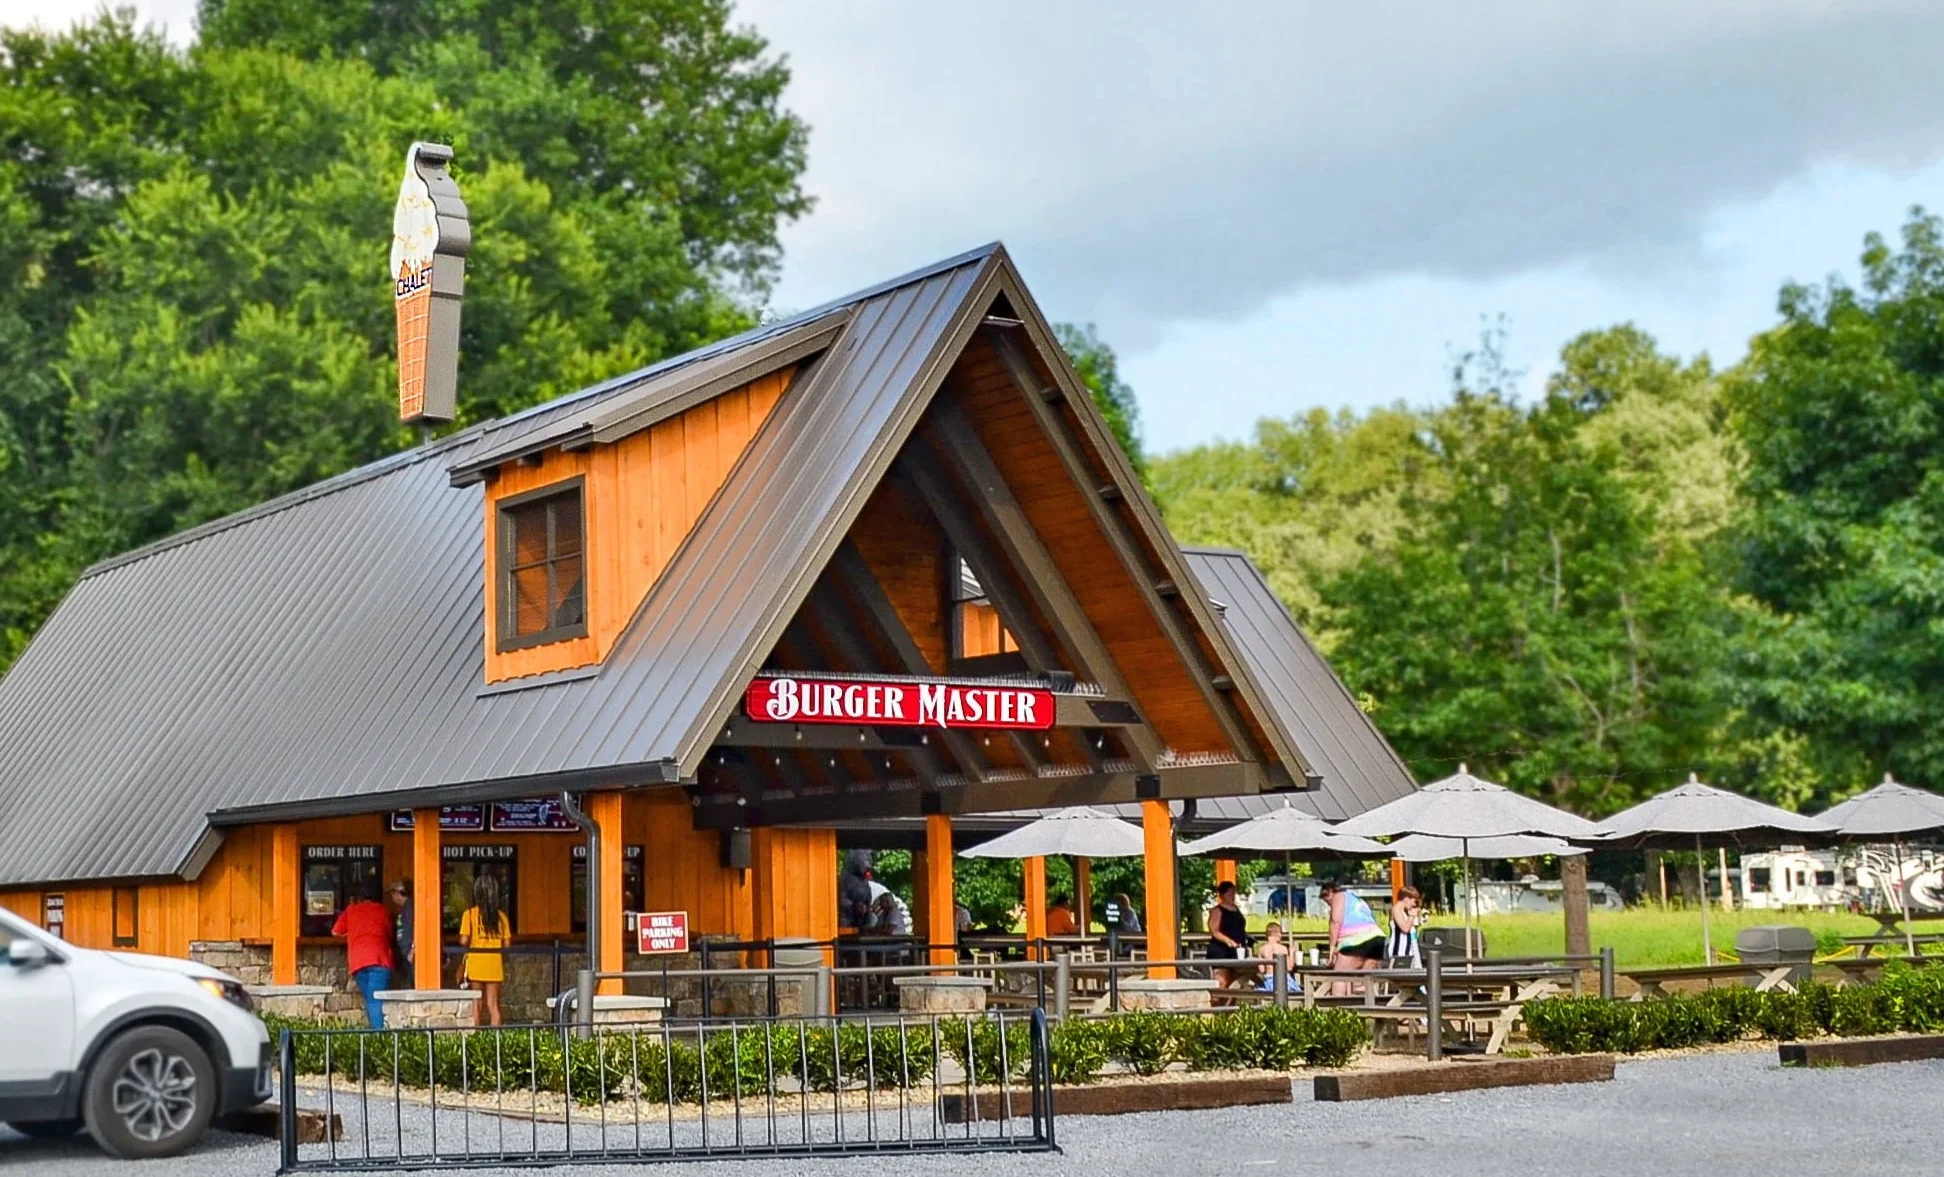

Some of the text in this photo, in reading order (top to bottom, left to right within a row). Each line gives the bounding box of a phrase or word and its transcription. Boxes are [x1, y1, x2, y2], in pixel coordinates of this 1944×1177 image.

[397, 267, 432, 296] CHALET
[766, 678, 1036, 728] BURGER MASTER
[308, 846, 375, 858] ORDER HERE
[443, 846, 514, 858] HOT PICK-UP
[651, 916, 674, 927] BIKE
[642, 926, 684, 939] PARKING
[651, 938, 676, 950] ONLY
